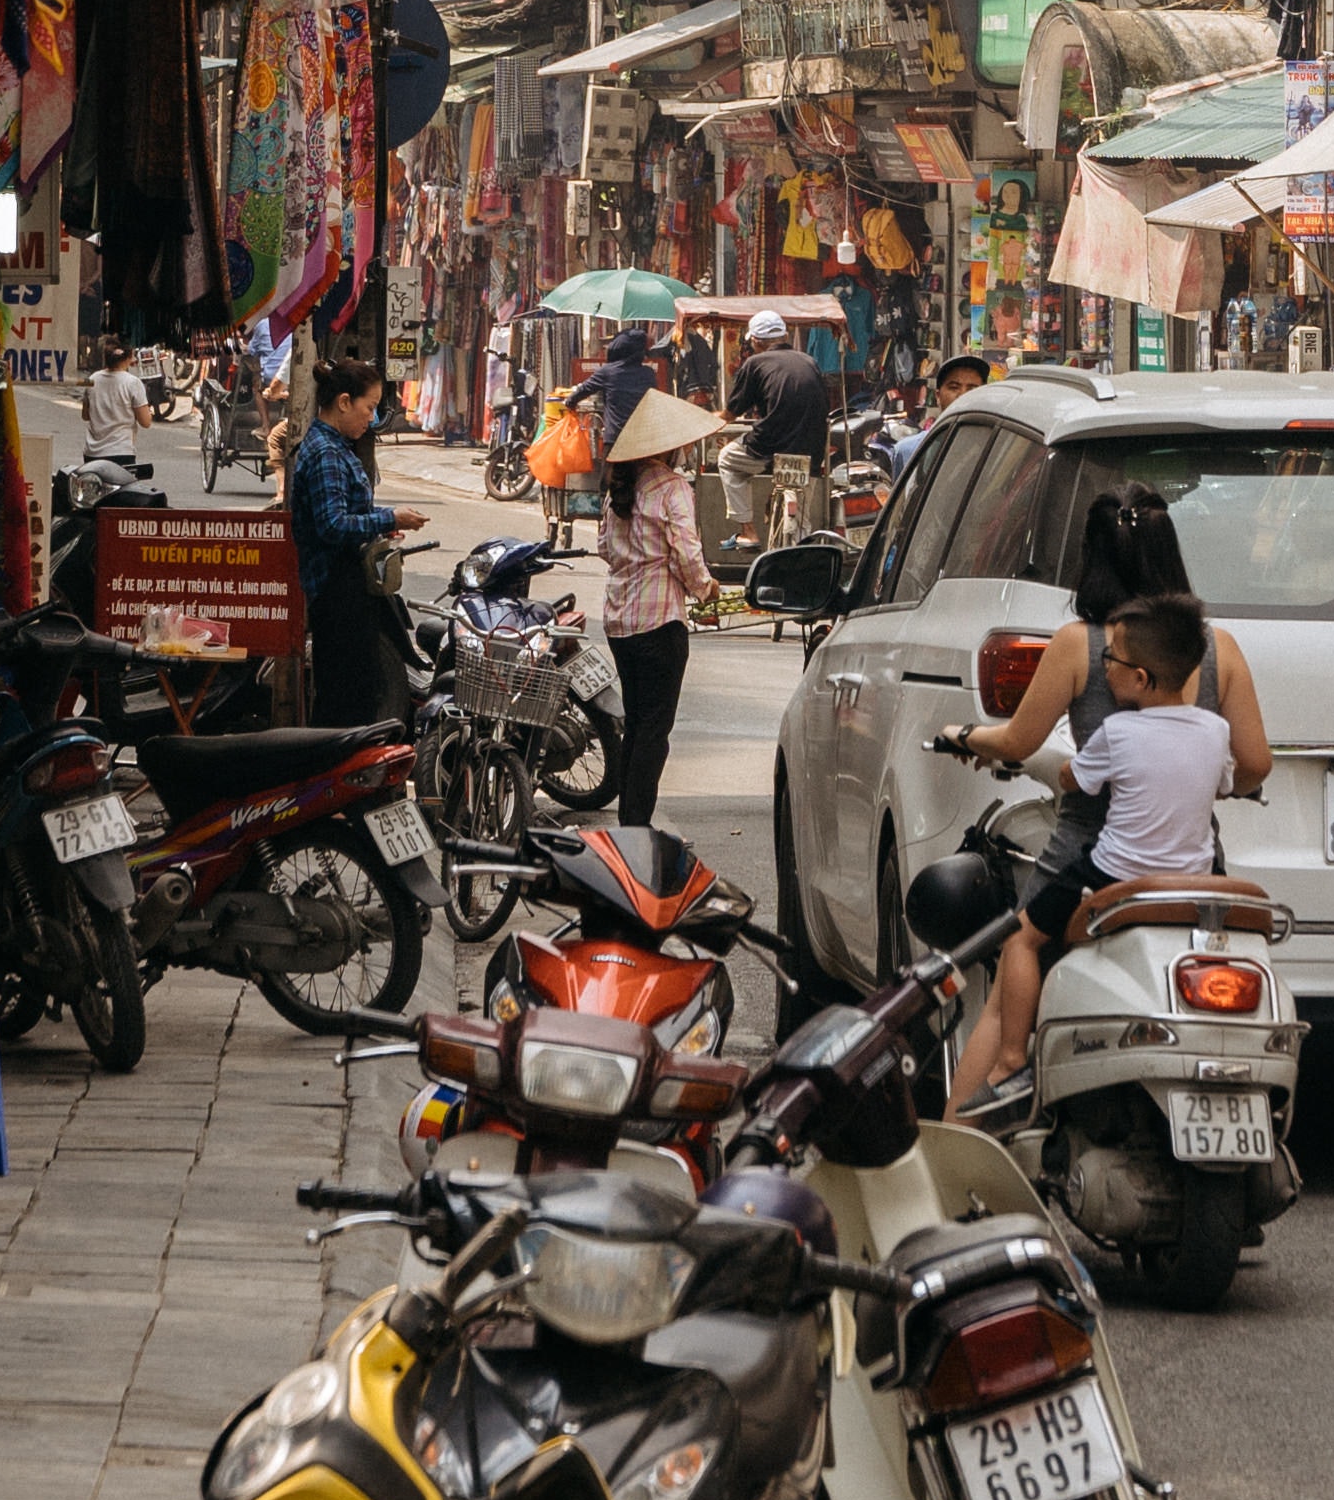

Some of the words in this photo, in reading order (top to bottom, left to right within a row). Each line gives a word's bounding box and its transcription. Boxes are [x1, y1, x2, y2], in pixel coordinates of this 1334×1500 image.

[390, 341, 415, 353] 420
[3, 348, 69, 383] ONEY
[775, 470, 807, 485] 0020
[118, 519, 158, 537] UBND
[161, 518, 201, 539] QUẬN
[205, 519, 245, 539] HOÀN
[140, 542, 188, 564] TUYẾN
[191, 543, 222, 564] PHỐ
[124, 579, 135, 592] XE
[155, 579, 166, 592] XE
[167, 577, 185, 593] MÁY
[187, 577, 208, 594] TRÊN
[198, 604, 218, 618] KINH
[218, 605, 246, 619] DOANH
[579, 666, 614, 694] 3543
[54, 801, 113, 834] 29-G1
[229, 796, 298, 831] Wave
[274, 806, 300, 822] 110
[373, 803, 418, 836] 29-U5
[57, 823, 129, 857] 721.43
[386, 827, 429, 858] 0101
[1184, 1094, 1254, 1124] 29-B1
[1180, 1126, 1267, 1156] 157.80
[968, 1394, 1084, 1468] 29-H9
